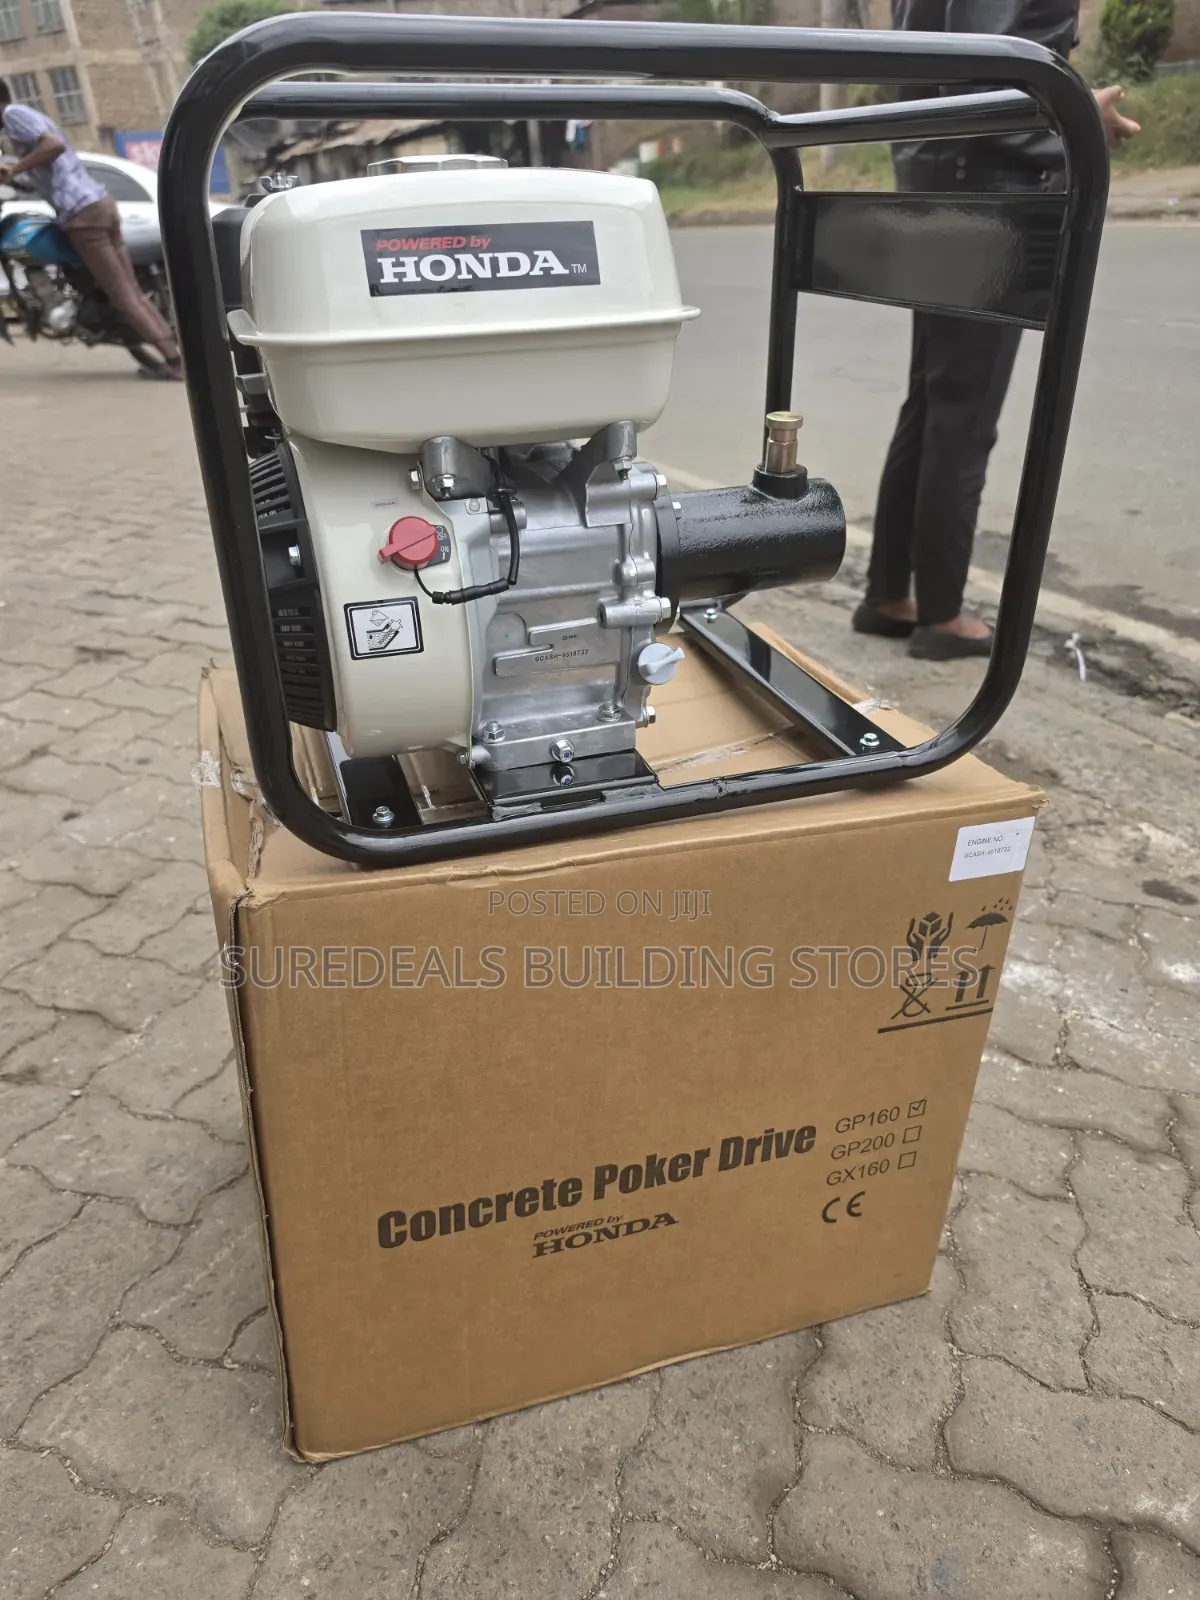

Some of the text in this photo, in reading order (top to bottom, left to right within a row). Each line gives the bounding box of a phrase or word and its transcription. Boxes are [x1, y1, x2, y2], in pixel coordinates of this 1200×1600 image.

[376, 236, 492, 252] POWERED by
[377, 250, 569, 283] HONDA
[967, 836, 992, 846] ENGINE
[834, 1105, 901, 1134] GP160
[830, 1132, 895, 1160] GP200
[826, 1158, 890, 1186] GX160
[377, 1125, 817, 1249] Concrete Poker Drive
[532, 1212, 680, 1259] HONDA
[533, 1214, 624, 1241] POWERED by
